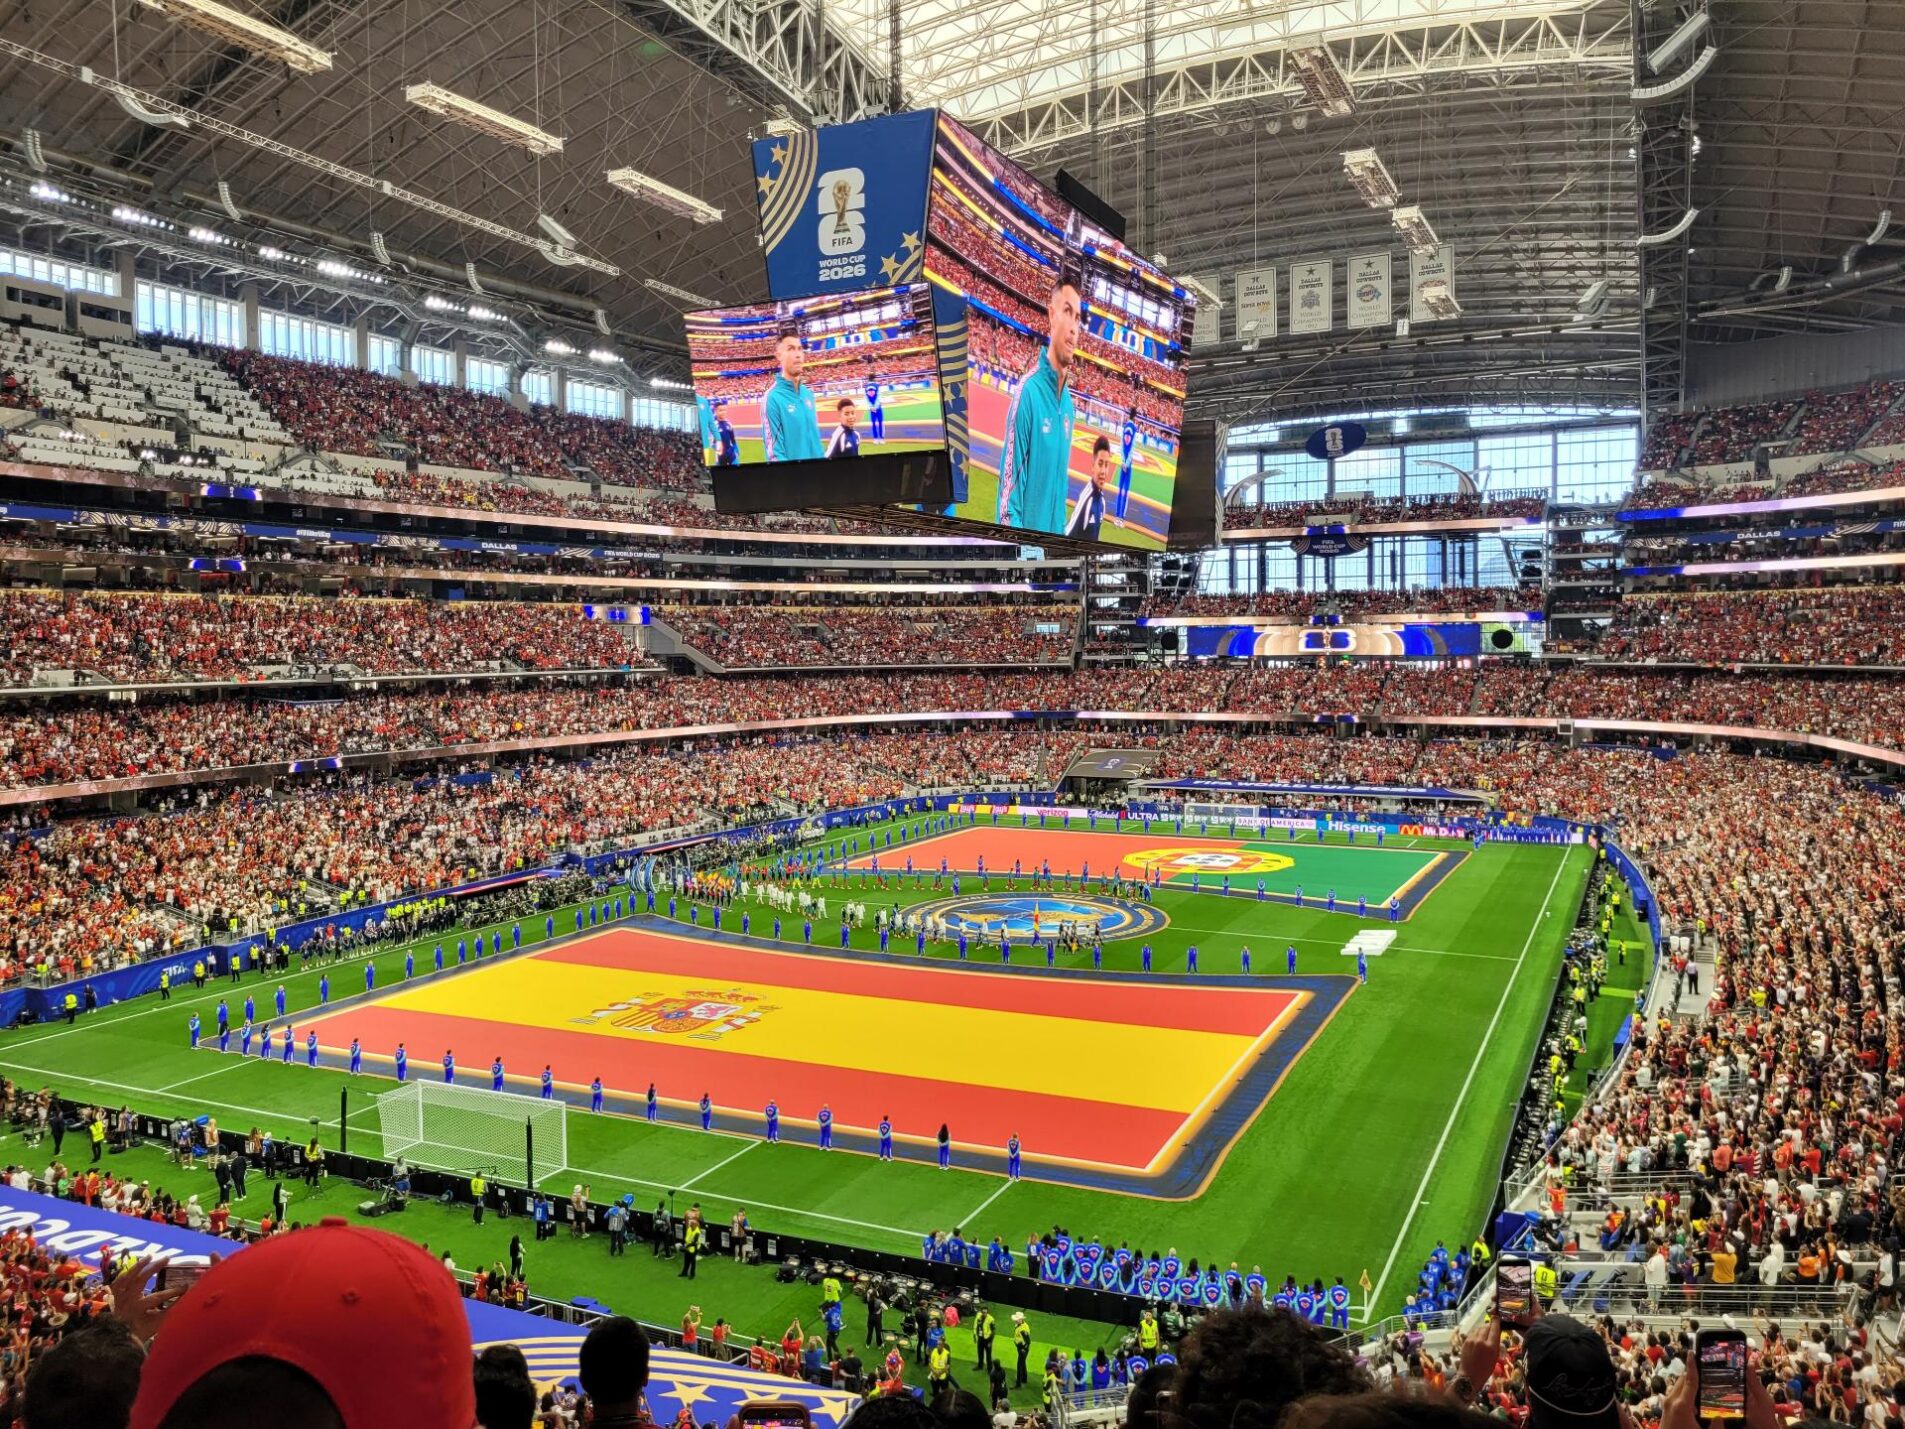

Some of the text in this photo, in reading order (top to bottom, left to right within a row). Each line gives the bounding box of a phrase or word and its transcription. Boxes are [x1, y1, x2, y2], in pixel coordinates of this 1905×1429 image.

[832, 237, 853, 247] FIFA
[819, 255, 866, 267] WORLD CUP
[819, 263, 866, 281] 2026
[1737, 530, 1781, 539] DALLAS
[481, 542, 518, 551] DALLAS
[1036, 808, 1069, 817] verizon
[1128, 812, 1159, 821] ULTRA
[1272, 819, 1306, 827] AMERICA
[1328, 821, 1386, 832] Hisense
